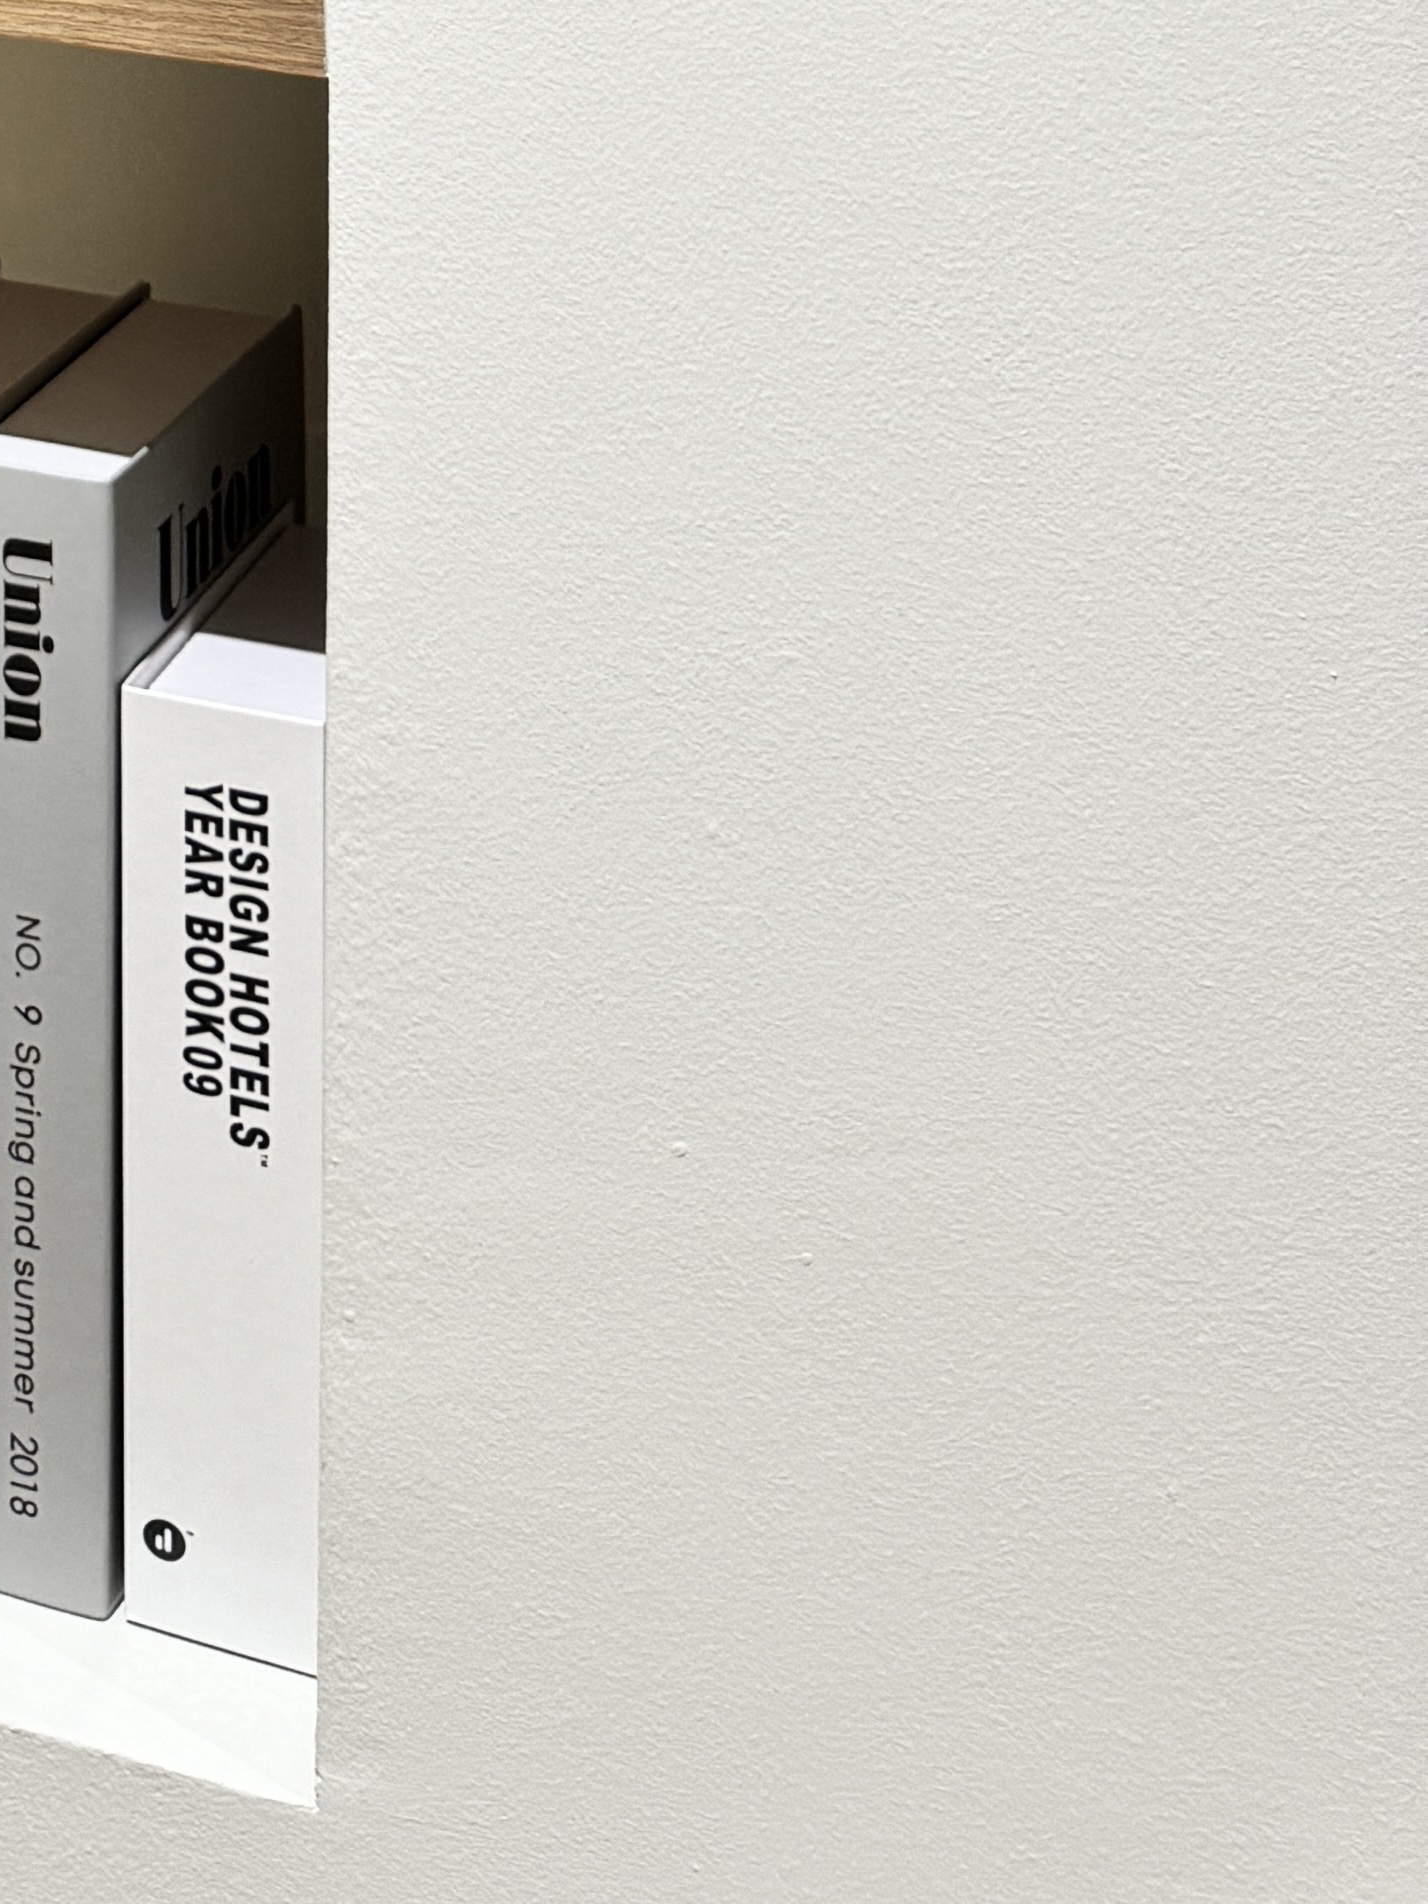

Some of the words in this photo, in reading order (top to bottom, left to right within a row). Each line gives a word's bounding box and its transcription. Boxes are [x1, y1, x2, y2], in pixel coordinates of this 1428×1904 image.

[158, 443, 271, 621] Union
[2, 537, 55, 742] Union
[184, 784, 224, 898] YEAR
[228, 787, 270, 957] DESIGN
[15, 914, 42, 978] NO.
[13, 1005, 43, 1026] 9
[8, 1042, 42, 1165] Spring
[14, 1176, 41, 1251] and
[14, 1258, 35, 1414] summer
[9, 1432, 39, 1518] 2018
